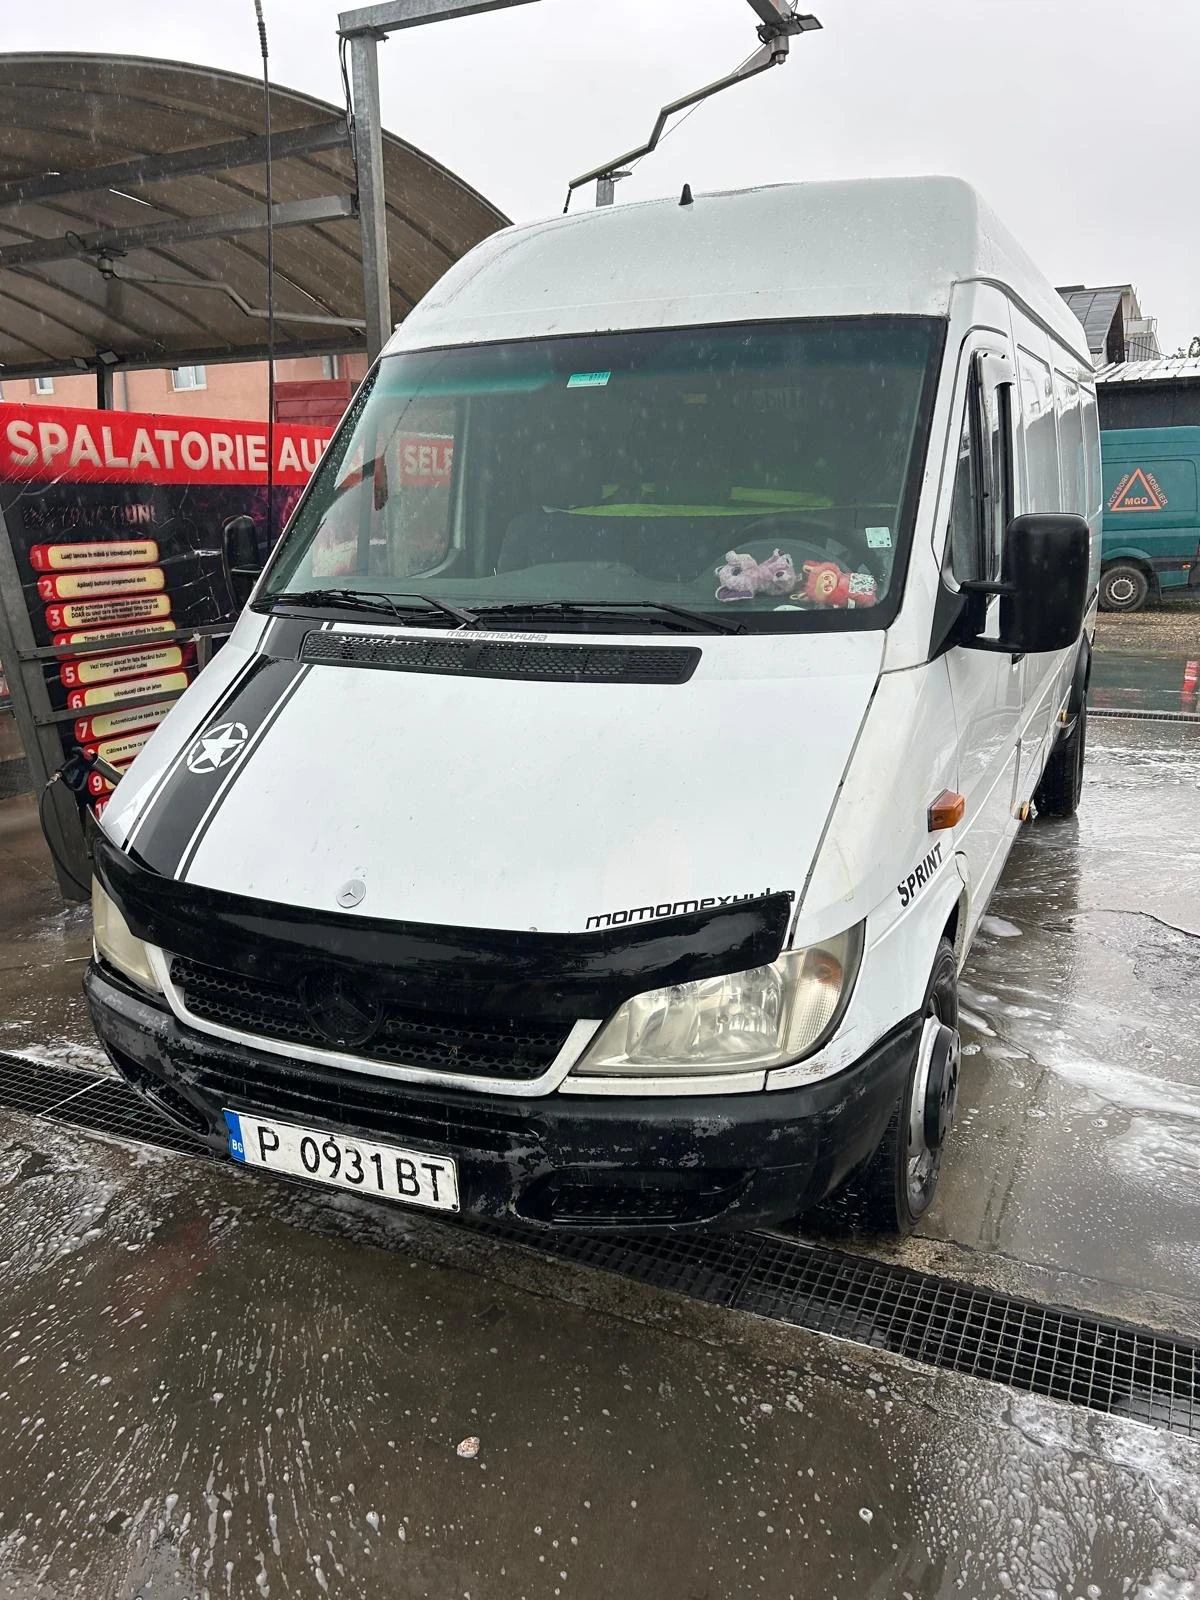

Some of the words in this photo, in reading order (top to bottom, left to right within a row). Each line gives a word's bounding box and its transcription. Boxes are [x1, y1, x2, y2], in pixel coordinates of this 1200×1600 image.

[6, 420, 268, 471] SPALATORIE
[1146, 473, 1169, 506] MOBILIER
[35, 551, 42, 567] 1
[43, 580, 53, 597] 2
[51, 609, 60, 626] 3
[65, 667, 75, 683] 5
[72, 695, 82, 709] 6
[79, 722, 88, 738] 7
[93, 775, 103, 791] 9
[897, 842, 942, 907] SPRINT
[232, 1139, 243, 1153] BG
[257, 1126, 279, 1161] P
